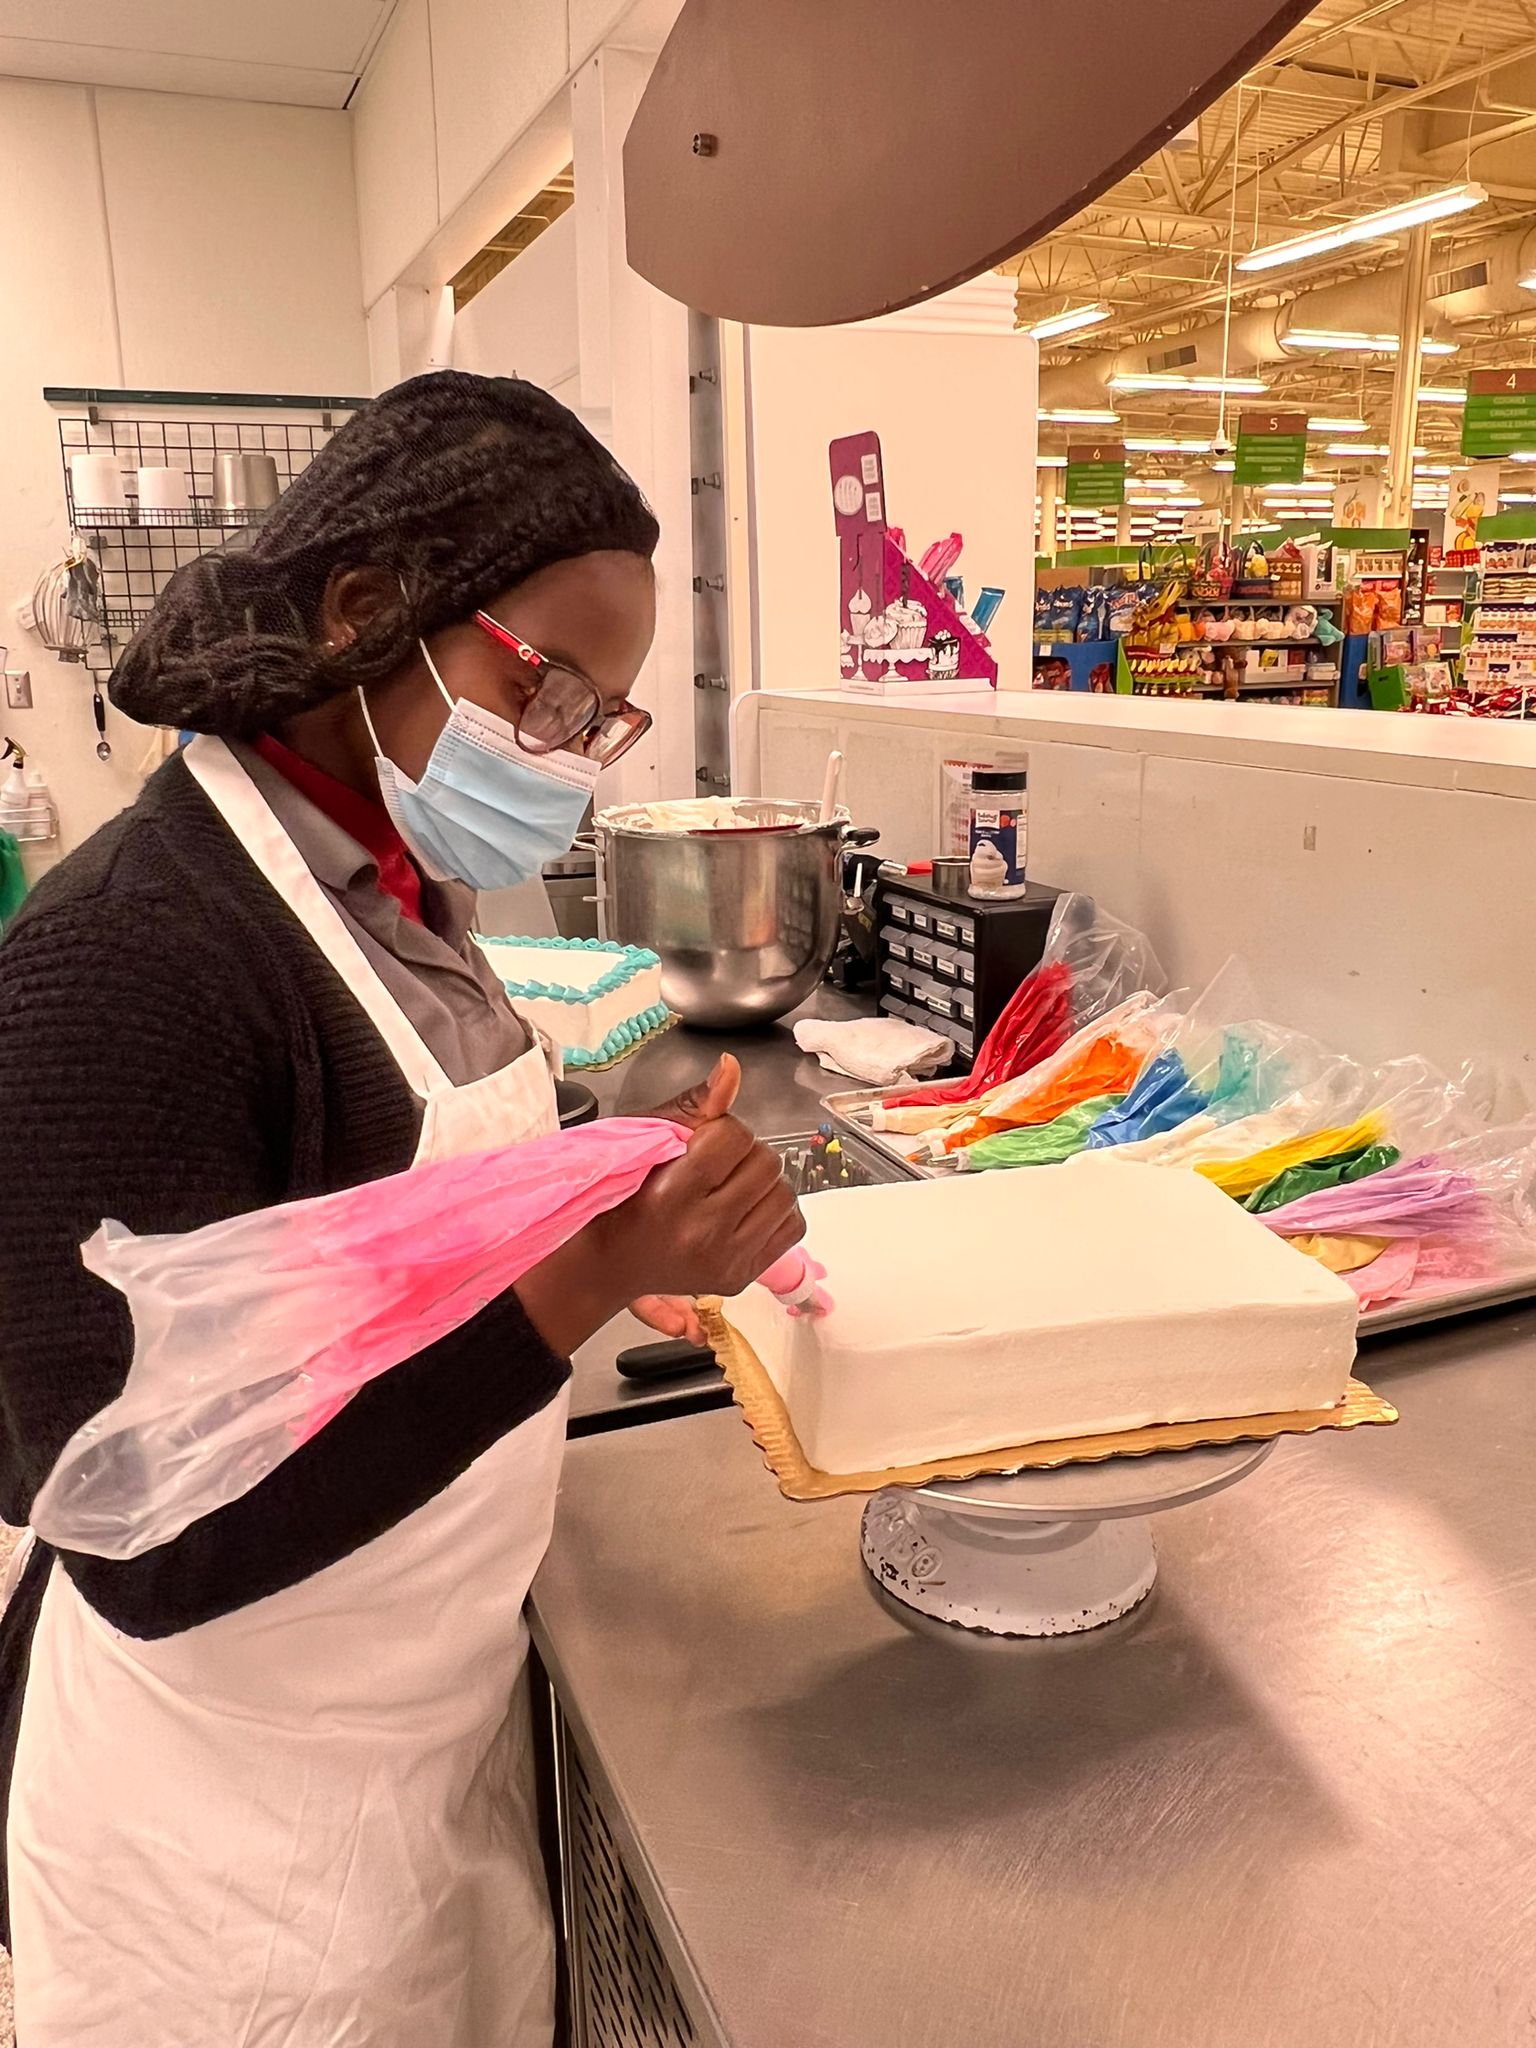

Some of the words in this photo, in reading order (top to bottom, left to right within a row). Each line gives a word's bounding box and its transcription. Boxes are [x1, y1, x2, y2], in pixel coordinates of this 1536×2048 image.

[1506, 373, 1517, 390] 4
[1269, 417, 1279, 431] 5
[1093, 448, 1101, 460] 6
